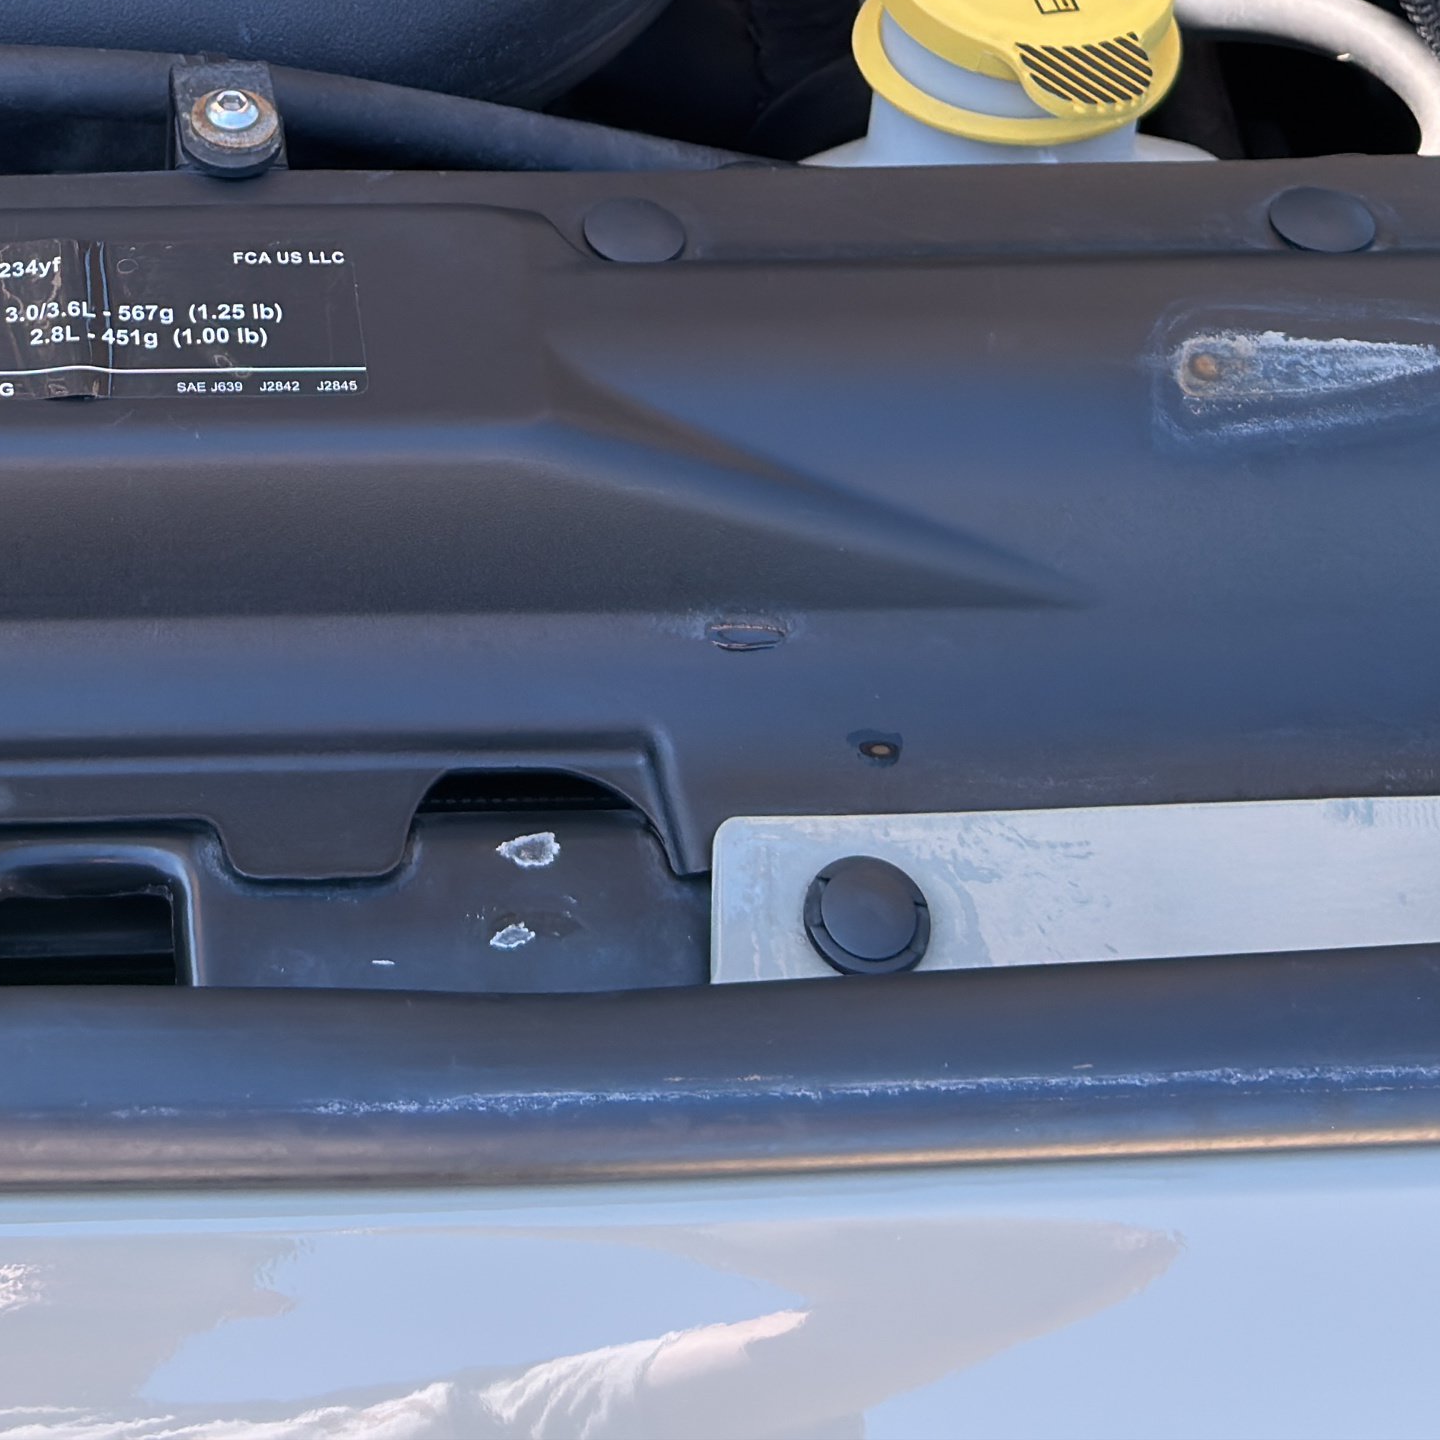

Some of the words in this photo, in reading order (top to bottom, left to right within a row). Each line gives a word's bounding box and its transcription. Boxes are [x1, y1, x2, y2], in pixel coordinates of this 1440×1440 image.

[232, 251, 272, 265] FCA
[276, 251, 303, 265] US
[308, 251, 345, 265] LLC
[5, 301, 97, 324] 3.0/3.6L
[117, 304, 174, 324] 567g
[188, 303, 246, 323] (1.25
[252, 302, 283, 323] lb)
[29, 325, 81, 346] 2.8L
[101, 328, 159, 349] 451g
[173, 327, 230, 348] (1.00
[237, 327, 269, 348] lb)
[176, 381, 206, 393] SAE
[210, 381, 243, 393] J639
[259, 380, 301, 392] J2842
[316, 379, 358, 392] J2845
